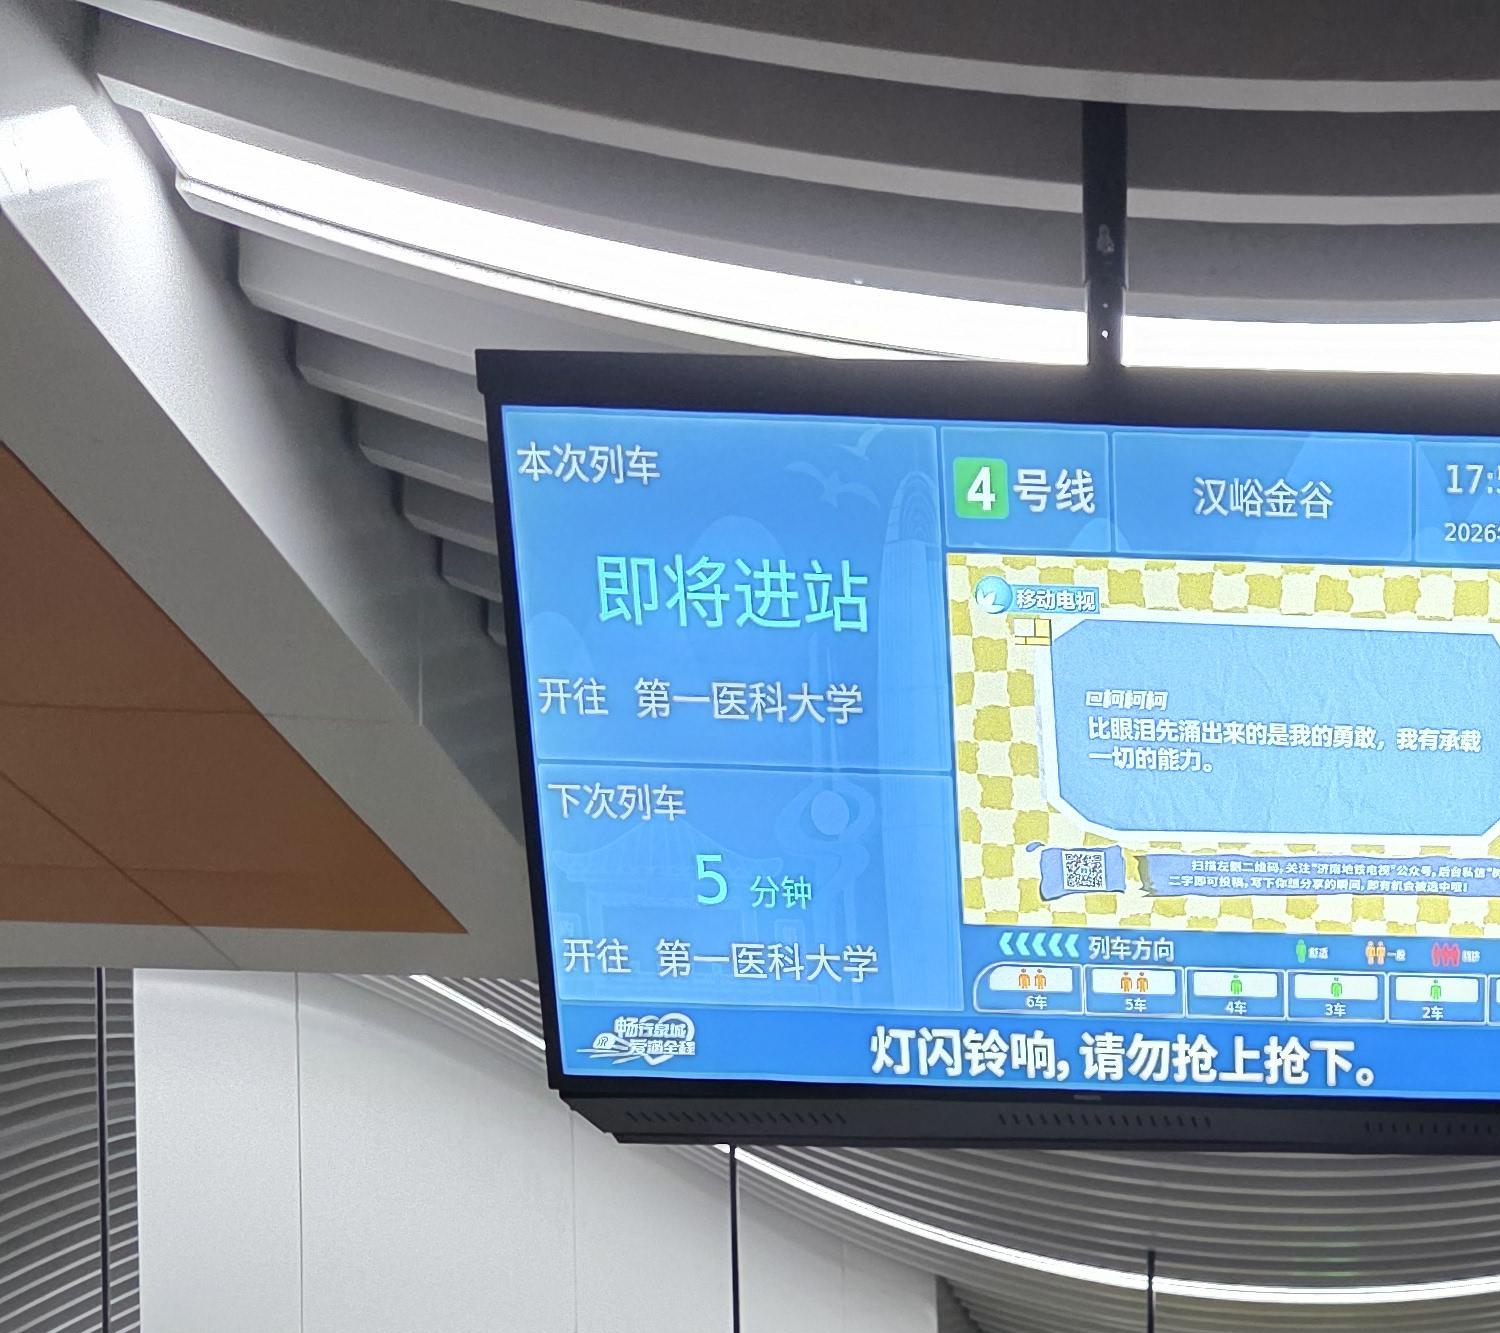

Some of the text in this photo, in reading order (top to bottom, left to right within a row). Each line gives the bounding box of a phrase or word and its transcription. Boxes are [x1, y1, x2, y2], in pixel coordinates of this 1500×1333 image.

[516, 442, 661, 485] 本次列车
[1193, 476, 1333, 520] 汉峪金谷
[597, 553, 869, 633] 即将进站
[1016, 587, 1097, 612] 移动电视
[537, 677, 864, 725] 开往 第一医科大学
[1088, 746, 1214, 773] 一切的能力。
[547, 782, 687, 821] 下次列车
[696, 853, 813, 910] 5 分钟
[562, 938, 878, 983] 开往 第一医科大学
[1088, 936, 1175, 962] 列车方向
[1026, 995, 1047, 1010] 6车
[1125, 997, 1148, 1013] 5车
[1225, 999, 1247, 1015] 4车
[1324, 1002, 1346, 1017] 3车
[1421, 1005, 1444, 1020] 2车
[870, 1025, 1375, 1088] 灯闪铃响，请勿抢上抢下。
